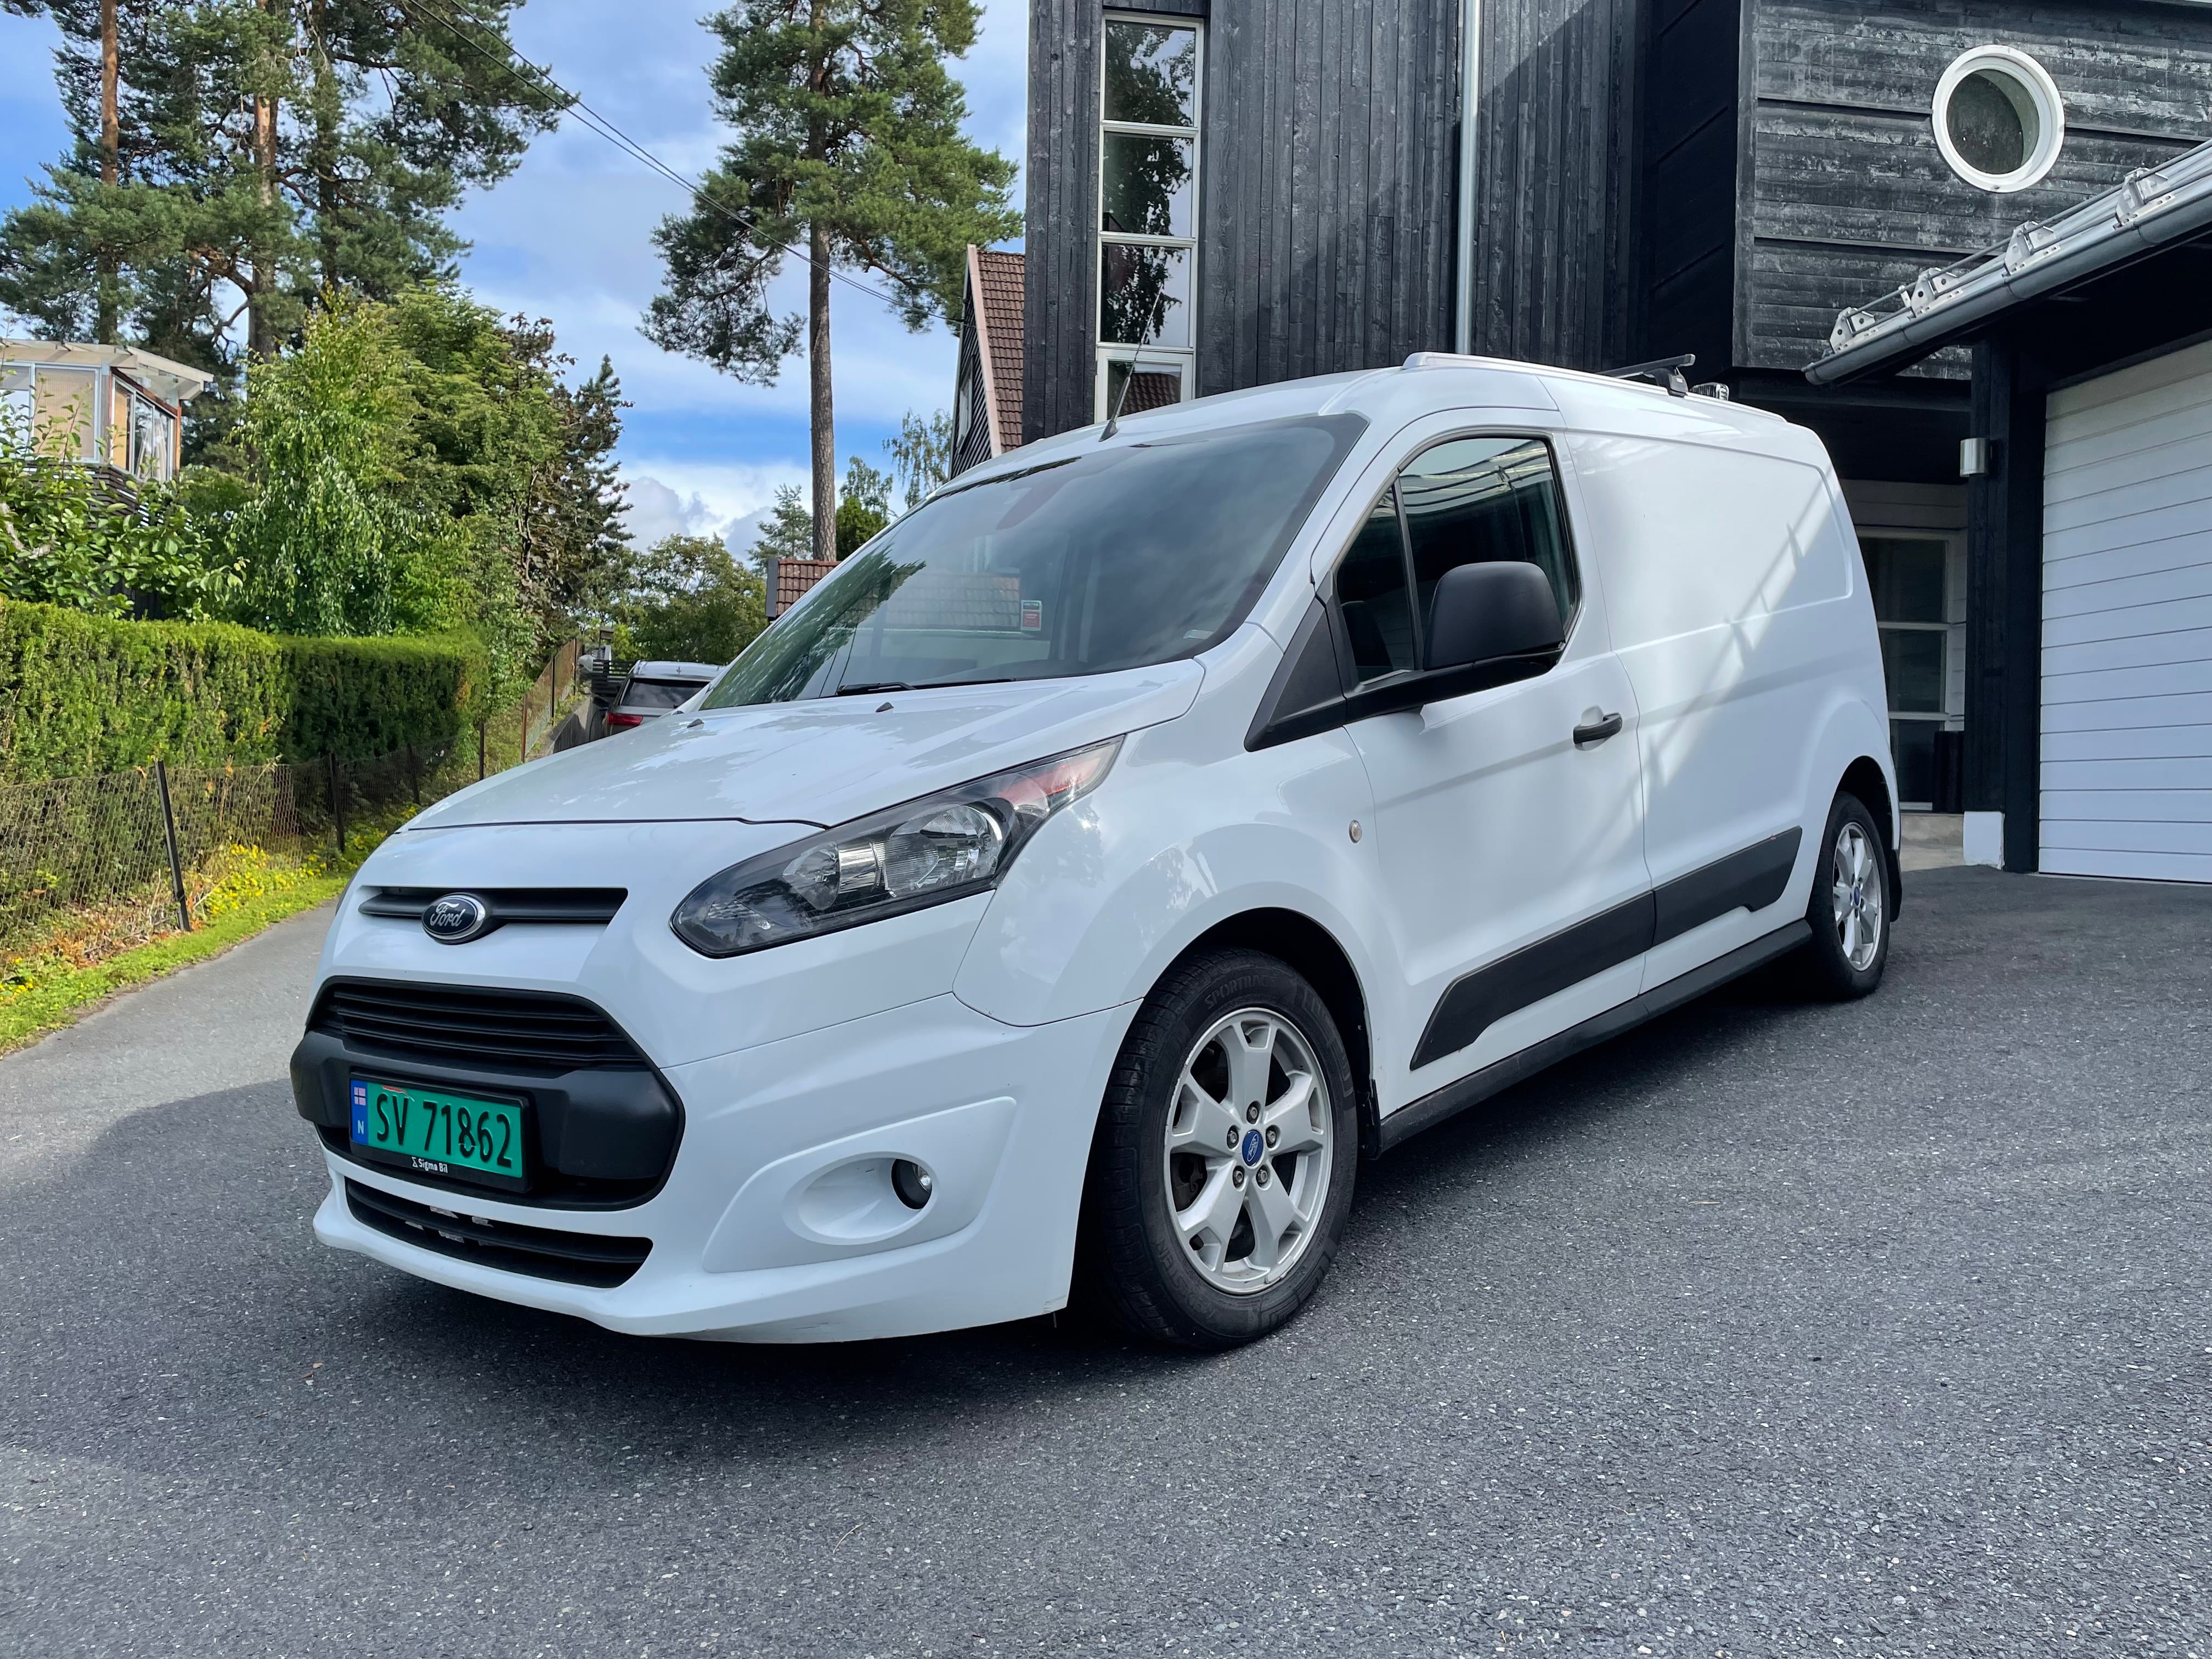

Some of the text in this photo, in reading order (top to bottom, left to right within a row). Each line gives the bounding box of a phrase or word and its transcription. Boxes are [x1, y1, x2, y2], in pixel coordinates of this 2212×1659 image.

[430, 901, 465, 927] Ford
[357, 1120, 364, 1135] N
[377, 1092, 512, 1168] SV 71862
[418, 1158, 448, 1173] Sigma Bil
